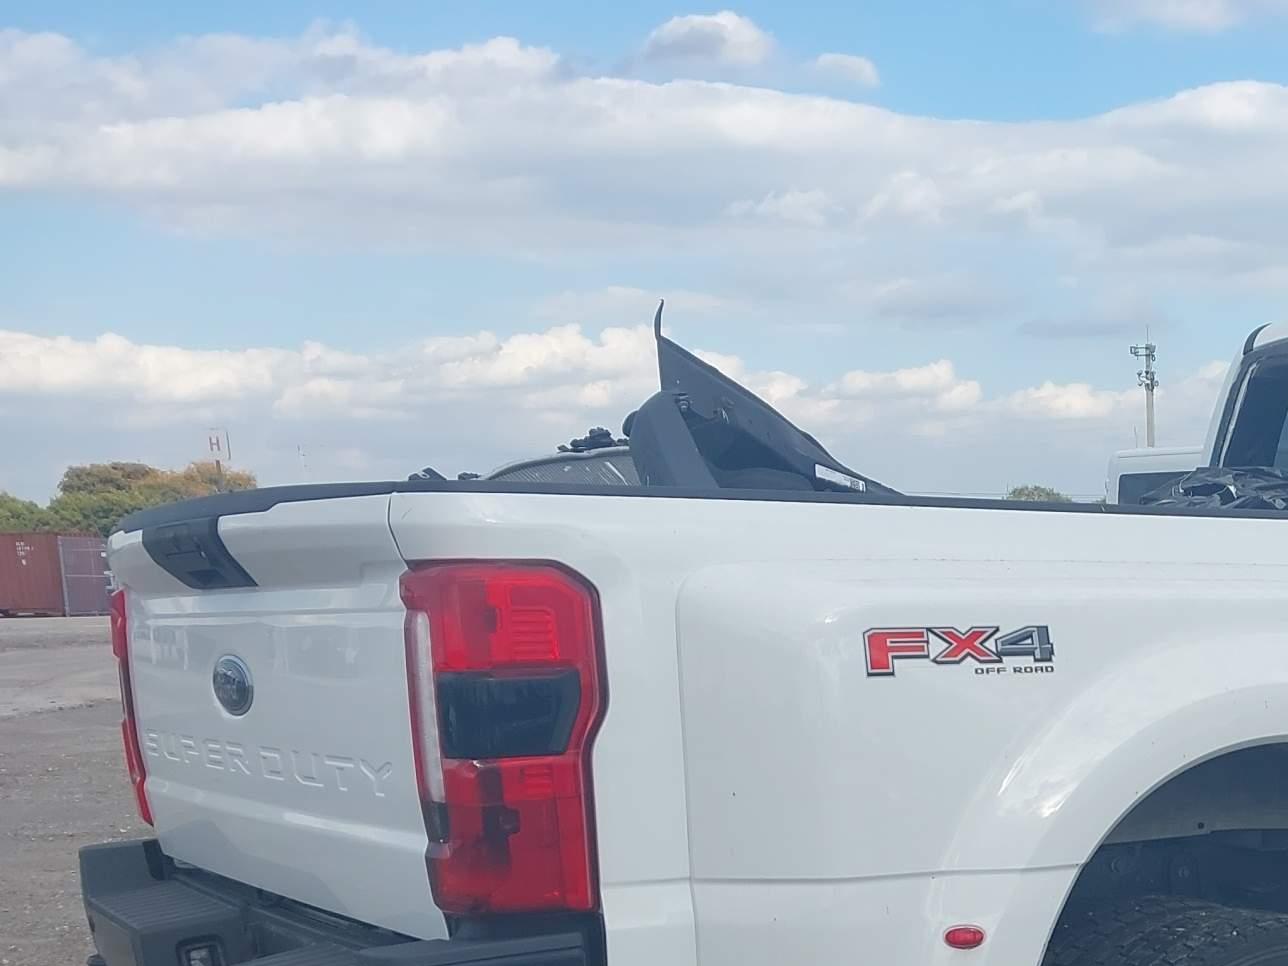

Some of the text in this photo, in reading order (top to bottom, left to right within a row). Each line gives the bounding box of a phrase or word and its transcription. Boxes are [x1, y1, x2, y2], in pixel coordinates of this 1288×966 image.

[862, 625, 1055, 677] FX4
[974, 665, 1055, 675] OFF ROAD
[146, 728, 393, 797] SUPER DUTY
